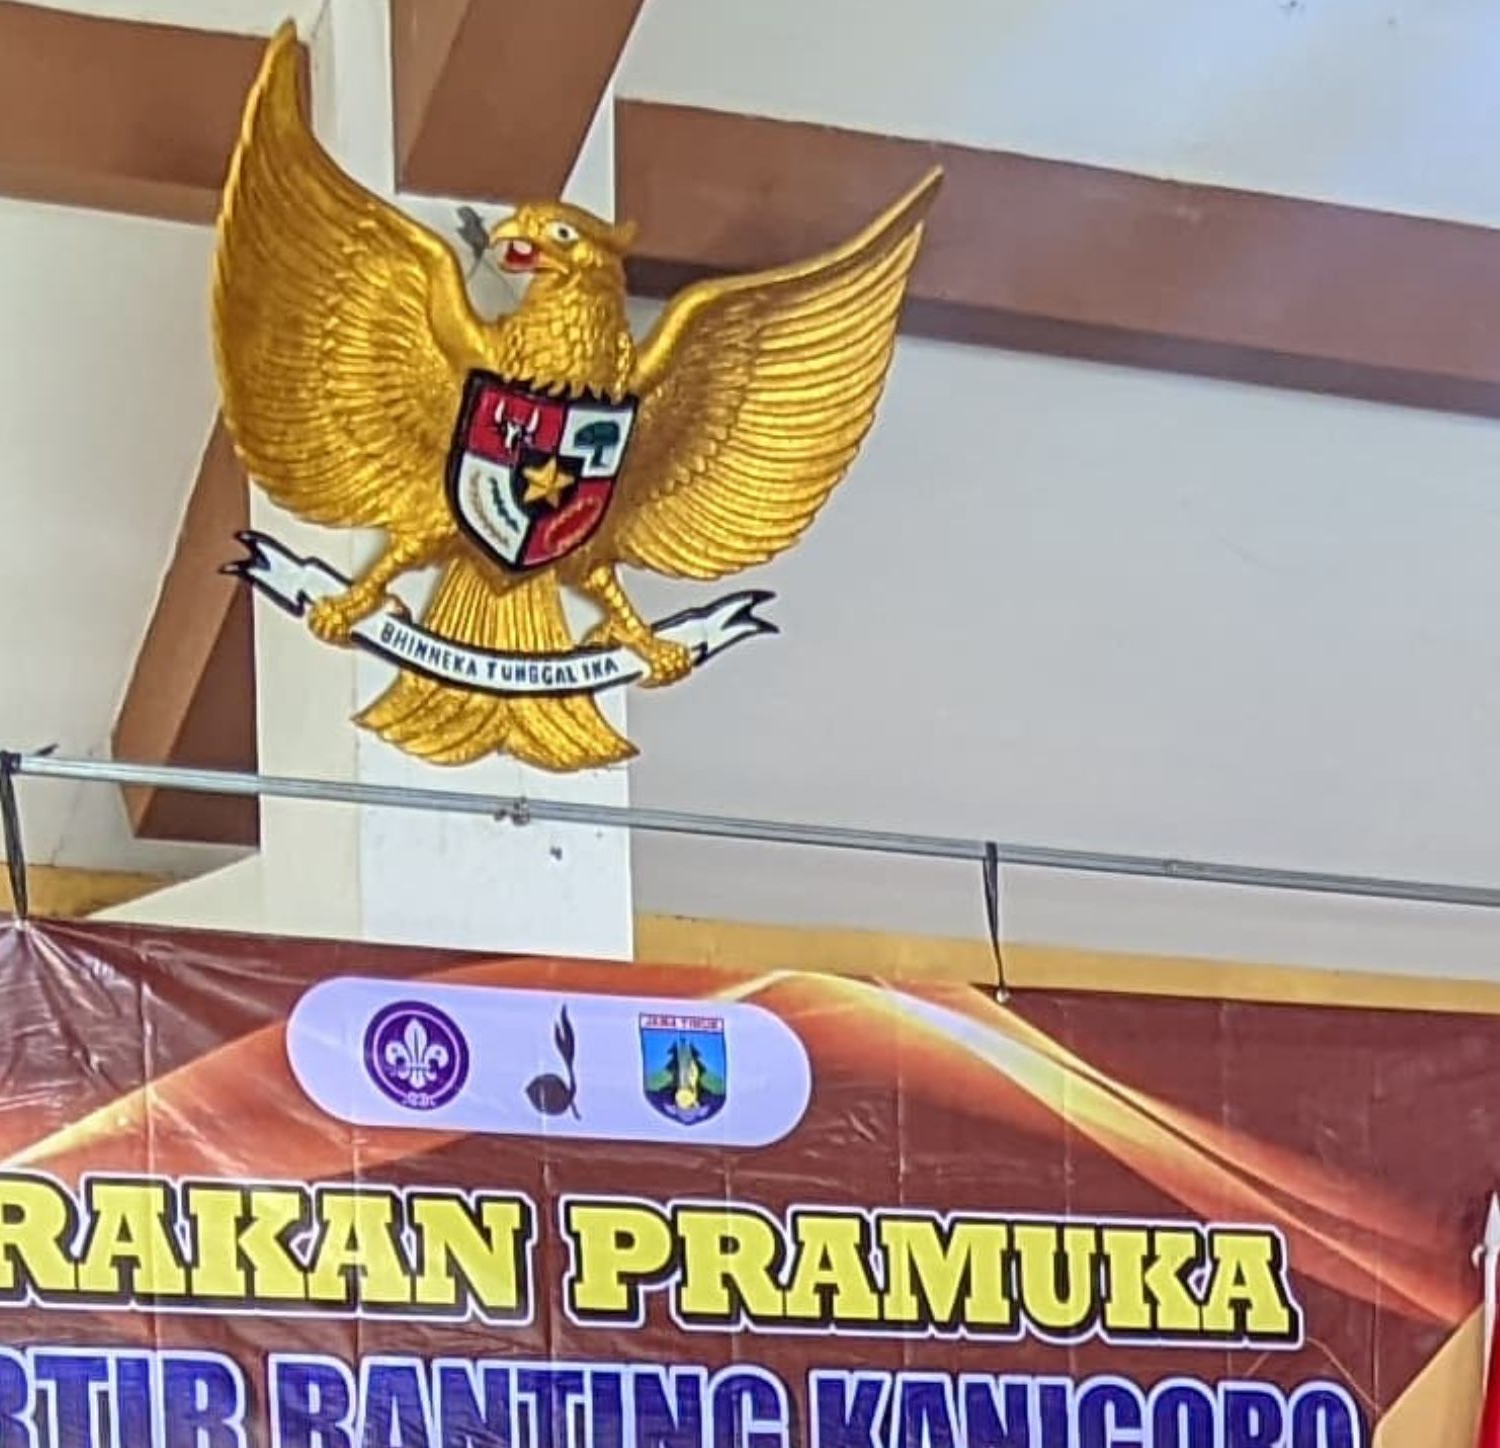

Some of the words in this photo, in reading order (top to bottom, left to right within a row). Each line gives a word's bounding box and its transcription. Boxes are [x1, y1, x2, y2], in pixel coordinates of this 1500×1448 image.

[380, 623, 477, 678] BHINNEKA
[487, 660, 577, 685] TUNGGAL
[582, 656, 619, 680] IKA
[564, 1200, 1299, 1344] PRAMUKA
